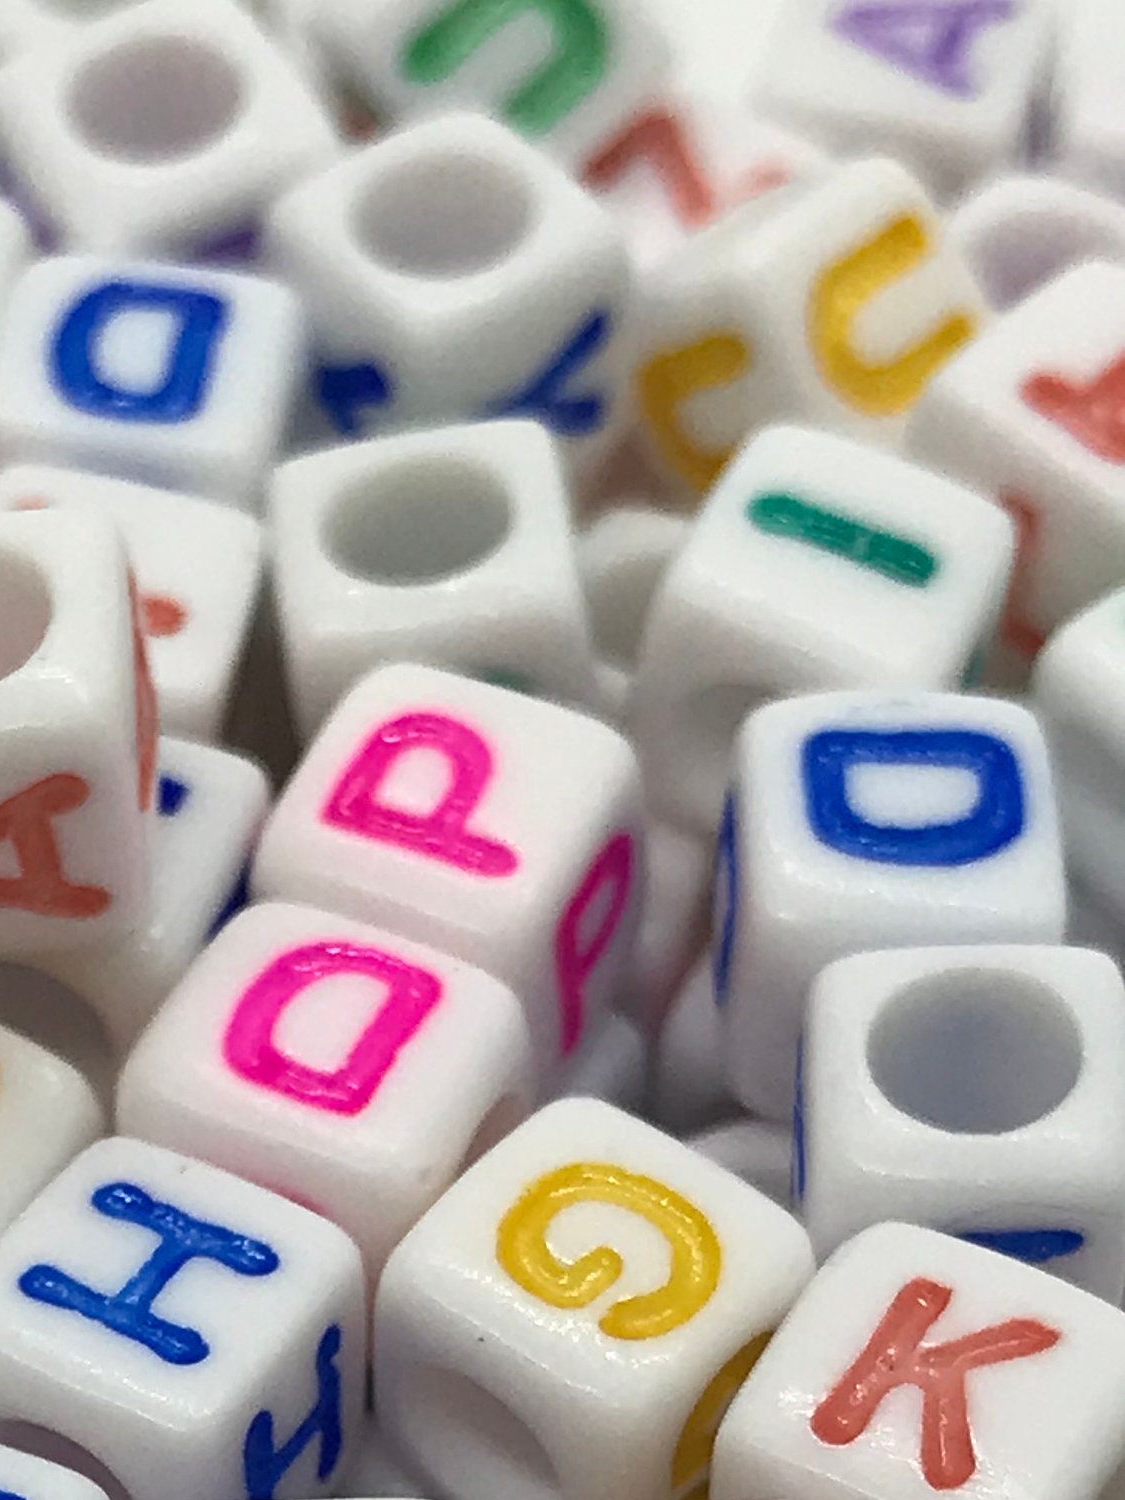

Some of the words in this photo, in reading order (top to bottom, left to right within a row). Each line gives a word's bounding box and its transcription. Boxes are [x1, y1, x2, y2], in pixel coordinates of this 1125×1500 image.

[828, 0, 1017, 101] A
[47, 276, 233, 426] D
[745, 491, 939, 588] I
[316, 706, 522, 880] P
[799, 727, 1030, 868] D
[218, 936, 448, 1120] D
[18, 1181, 281, 1367] H
[495, 1161, 724, 1340] G
[811, 1277, 1061, 1490] K
